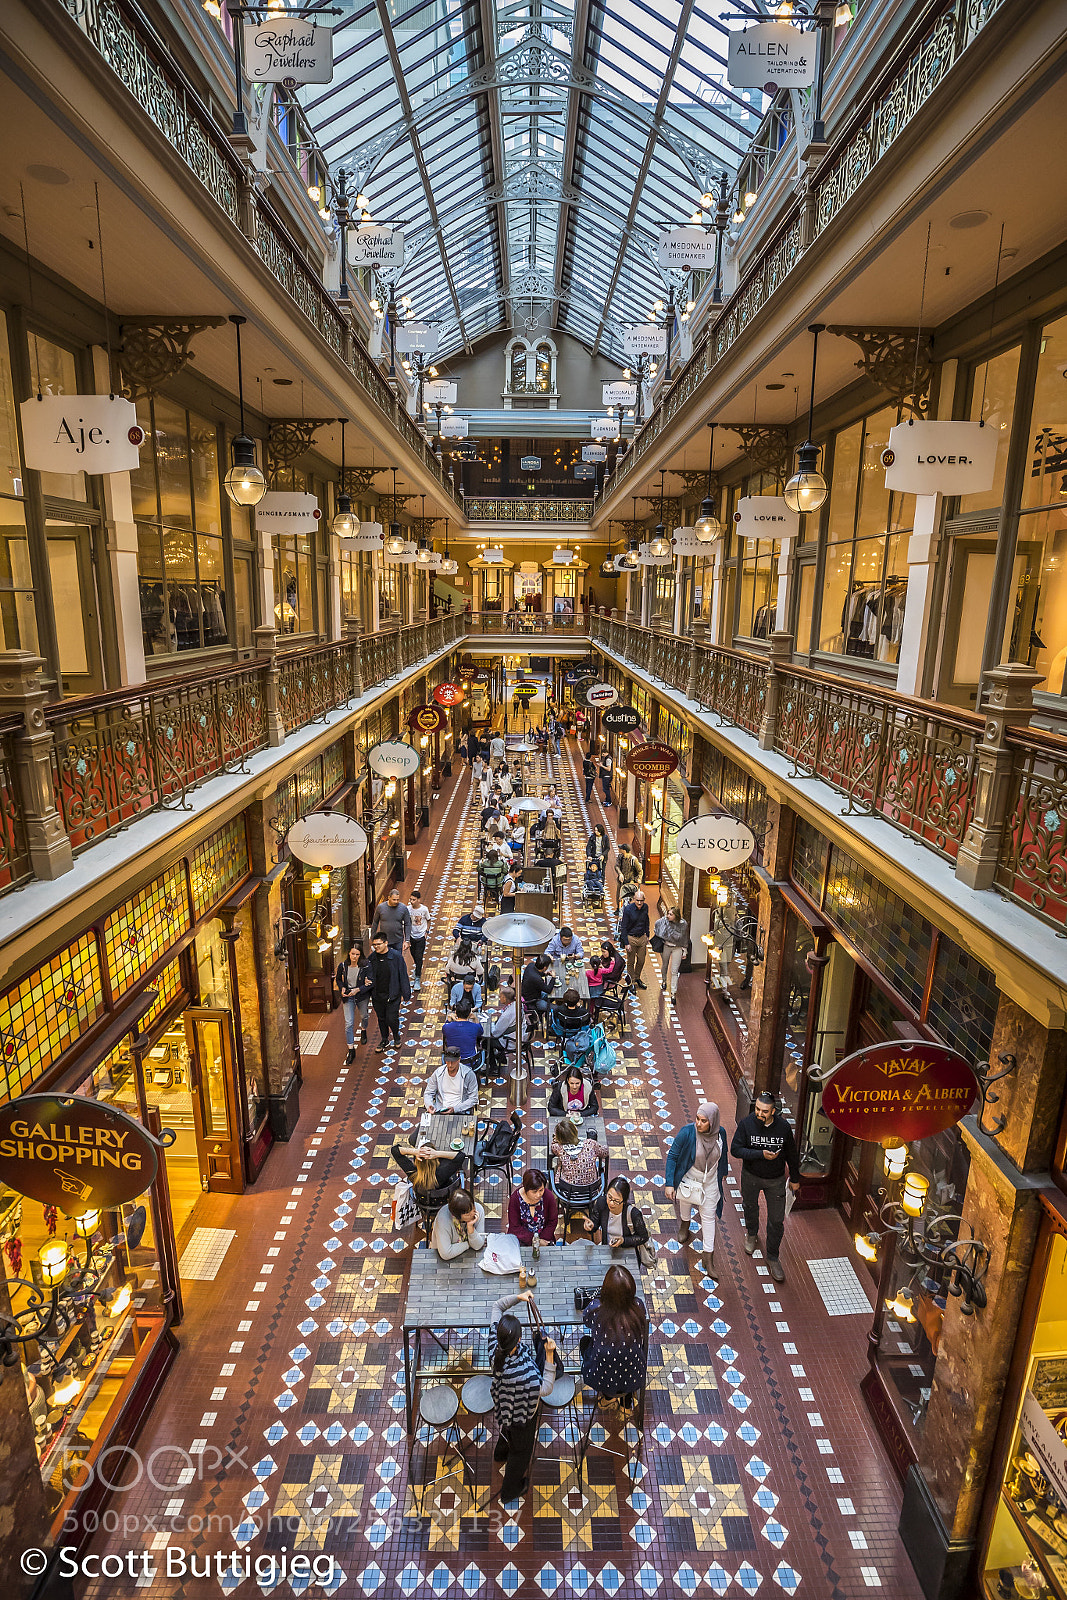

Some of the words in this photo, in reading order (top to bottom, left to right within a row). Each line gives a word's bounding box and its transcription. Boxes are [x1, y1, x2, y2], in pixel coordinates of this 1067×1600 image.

[737, 43, 789, 57] ALLEN
[255, 49, 316, 77] Jewellers
[355, 244, 396, 262] Jewellers
[663, 242, 669, 250] A
[668, 252, 706, 260] SHOEMAKER
[54, 416, 110, 454] Aje.
[130, 431, 141, 440] 68
[883, 454, 894, 463] 69
[917, 455, 973, 465] LOVER.
[377, 753, 411, 767] Aesop
[633, 763, 671, 771] COOMBS
[681, 838, 750, 852] A-ESQUE
[833, 1083, 900, 1103] VICTORIA
[902, 1091, 912, 1102] &
[913, 1083, 971, 1105] ALBERT
[830, 1106, 895, 1115] ANTIQUES
[902, 1104, 968, 1113] JEWELLERY
[10, 1119, 130, 1150] GALLERY
[750, 1135, 784, 1144] HENLEYS
[0, 1138, 142, 1171] SHOPPING
